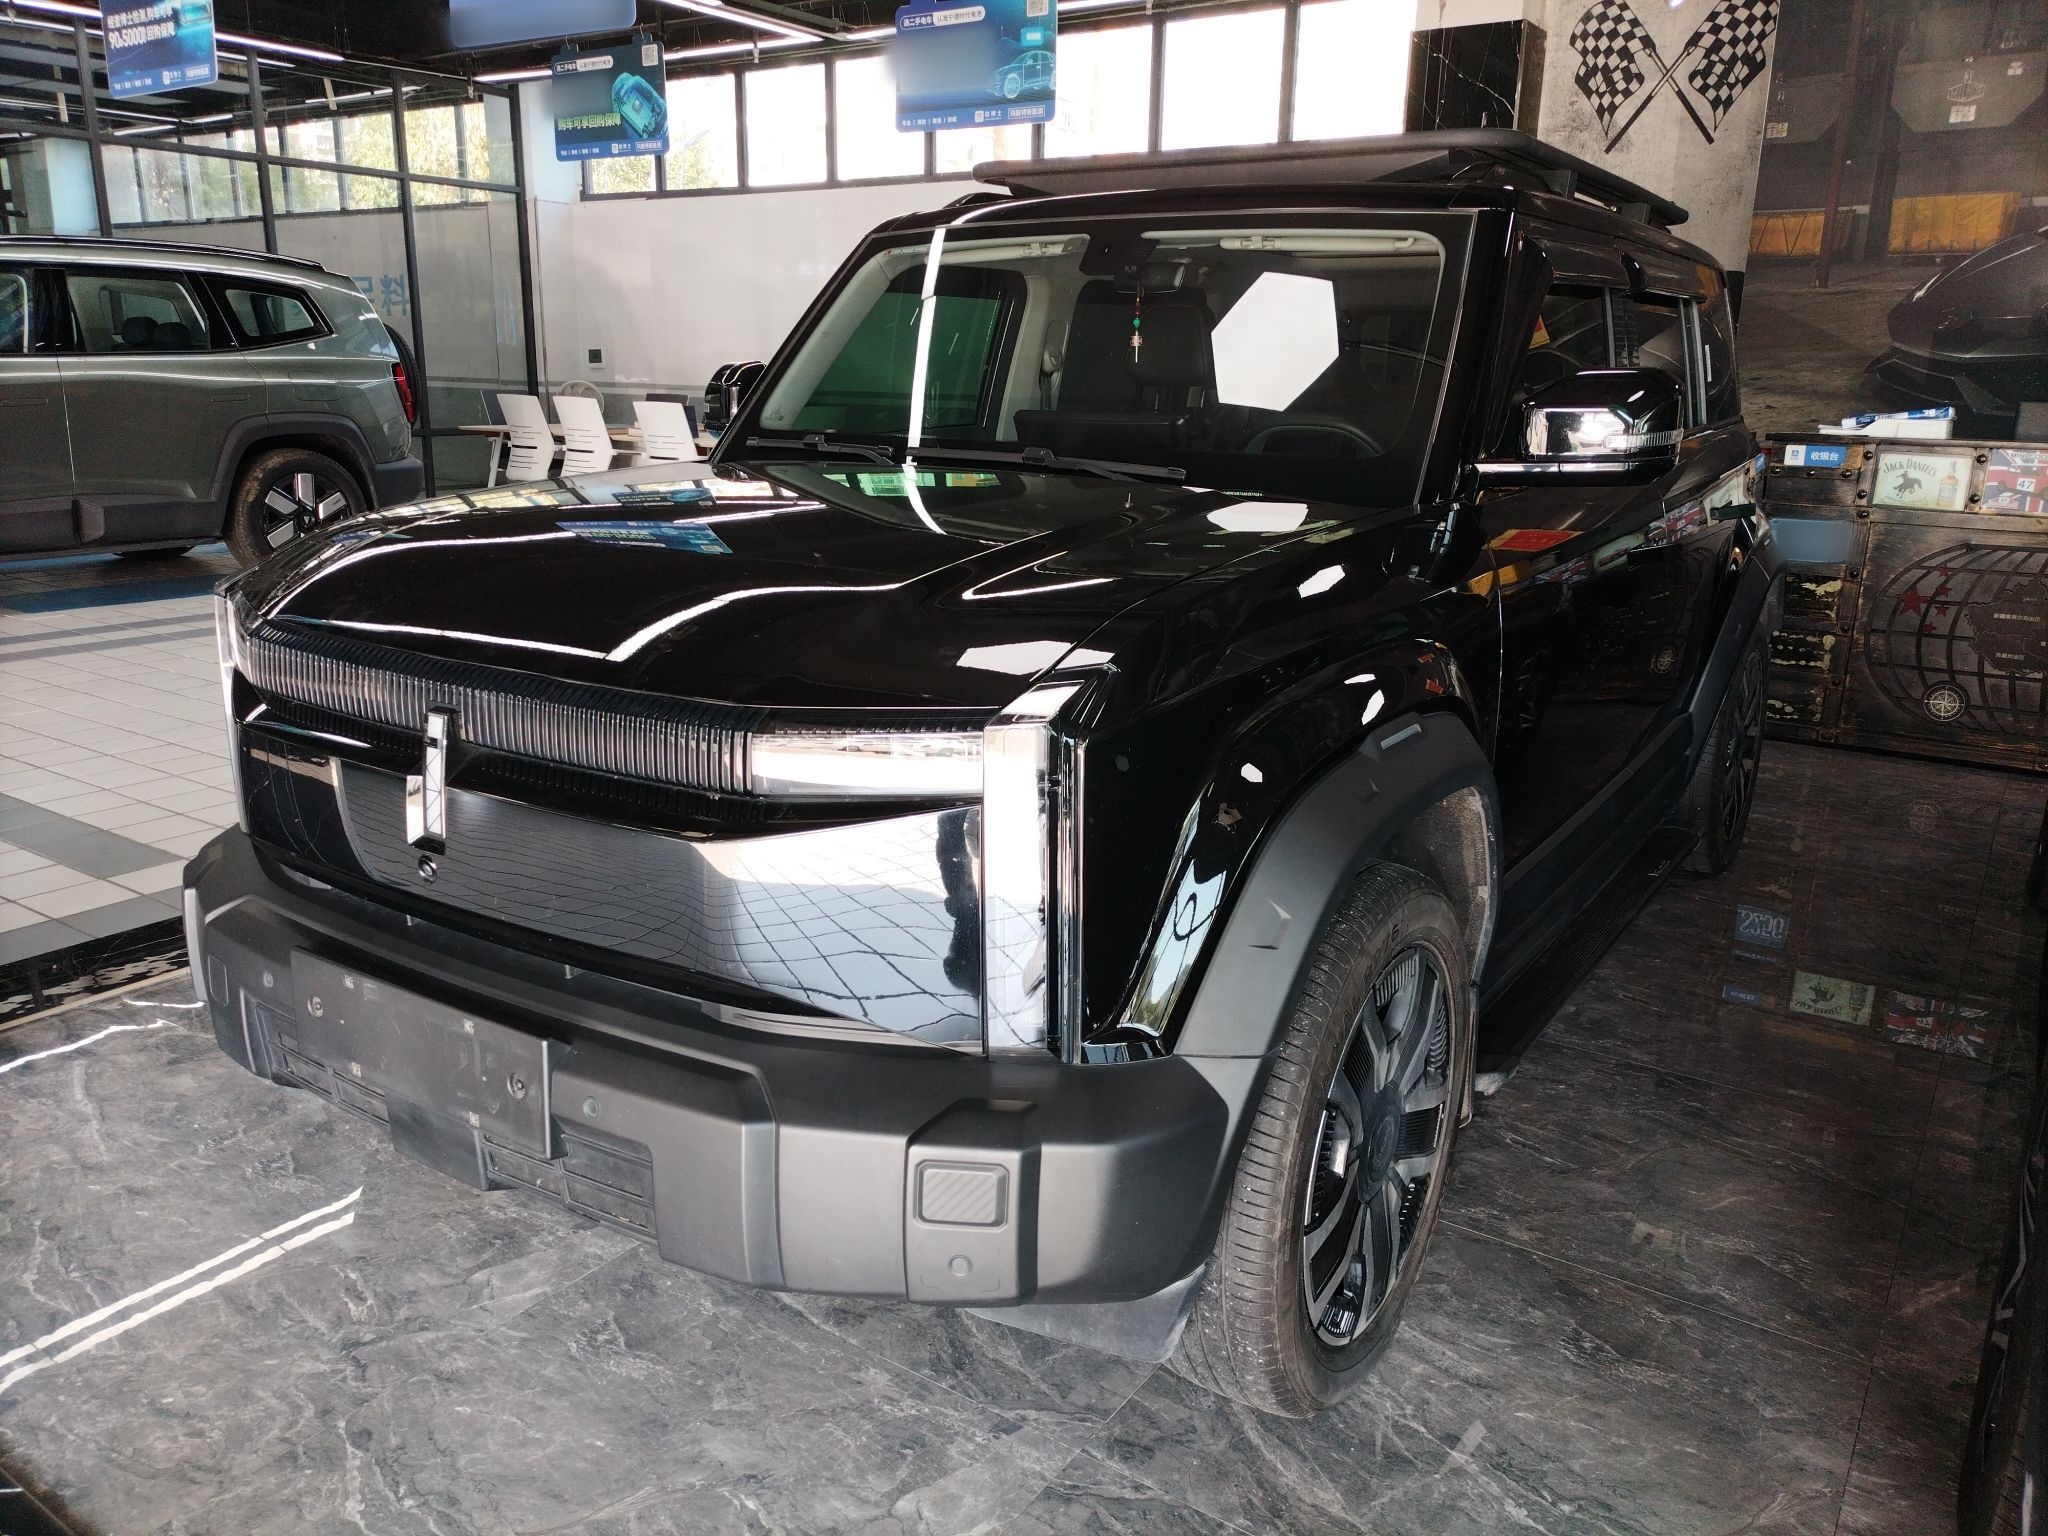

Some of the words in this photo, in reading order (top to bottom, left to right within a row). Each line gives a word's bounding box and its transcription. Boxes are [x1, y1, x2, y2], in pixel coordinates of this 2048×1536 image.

[1810, 451, 1839, 462] 收银台
[1883, 461, 1905, 474] JACK
[2018, 479, 2034, 490] 47
